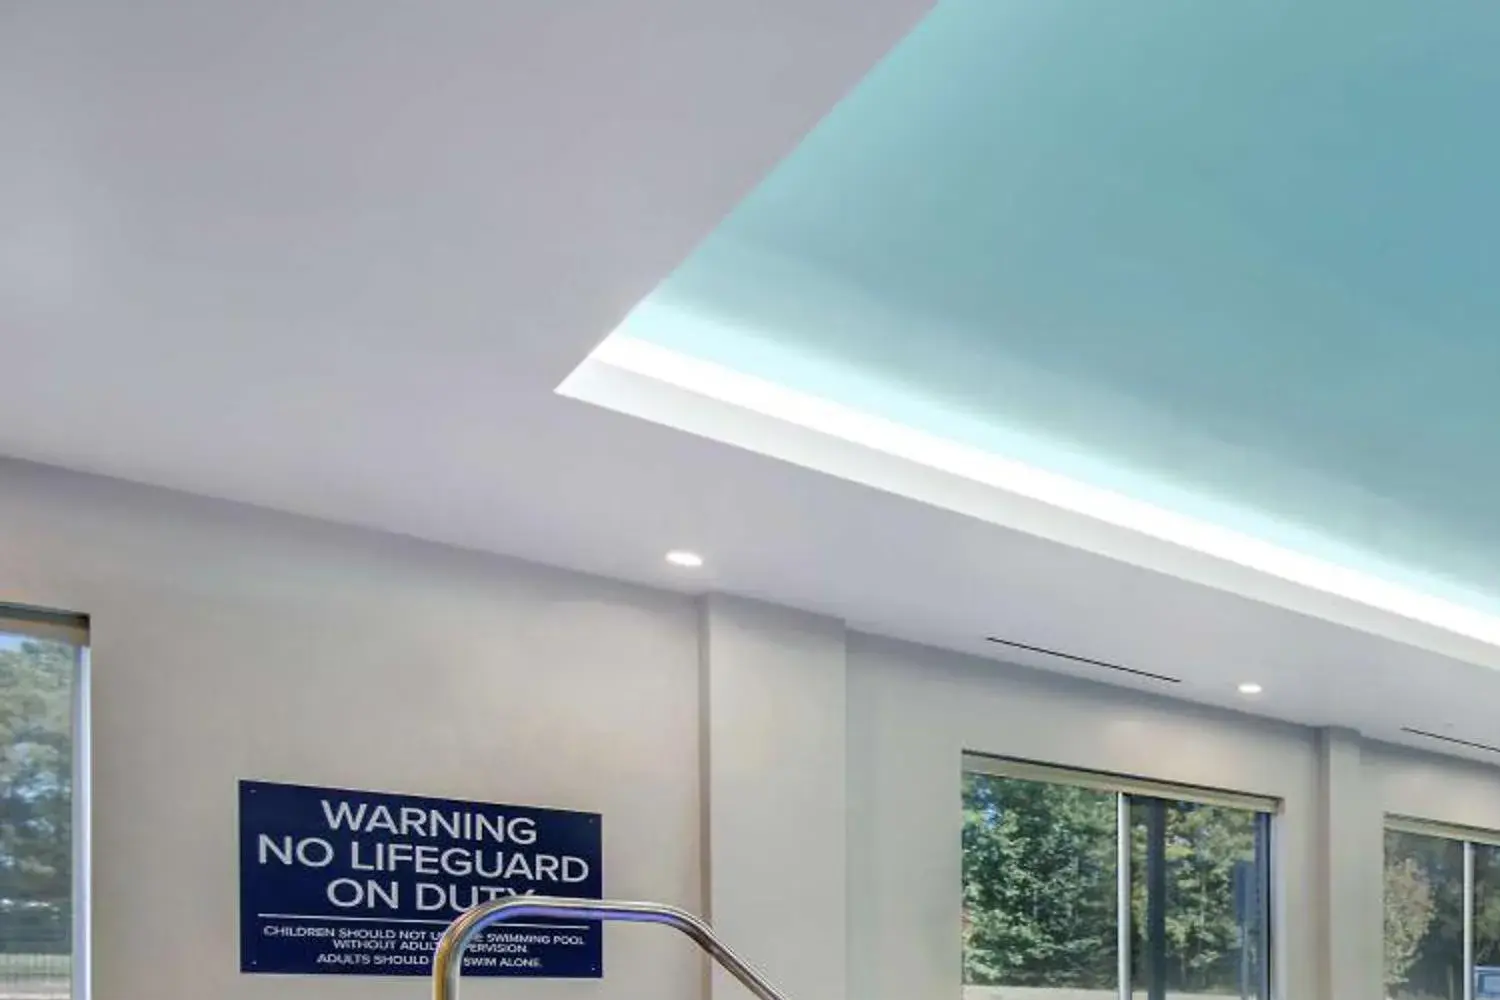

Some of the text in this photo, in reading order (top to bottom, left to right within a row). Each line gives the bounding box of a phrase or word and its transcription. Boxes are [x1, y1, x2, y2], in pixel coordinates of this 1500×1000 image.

[320, 799, 538, 845] WARNING
[257, 834, 590, 884] NO LIFEGUARD
[326, 878, 536, 912] ON DUT
[263, 925, 335, 938] CHILDREN
[338, 928, 396, 940] SHOULD
[399, 930, 426, 941] NOT
[486, 933, 551, 945] SWIMMING
[332, 939, 396, 950] WITHOUT
[316, 953, 371, 965] ADULTS
[372, 955, 429, 965] SHOULD
[463, 957, 497, 967] SWIM
